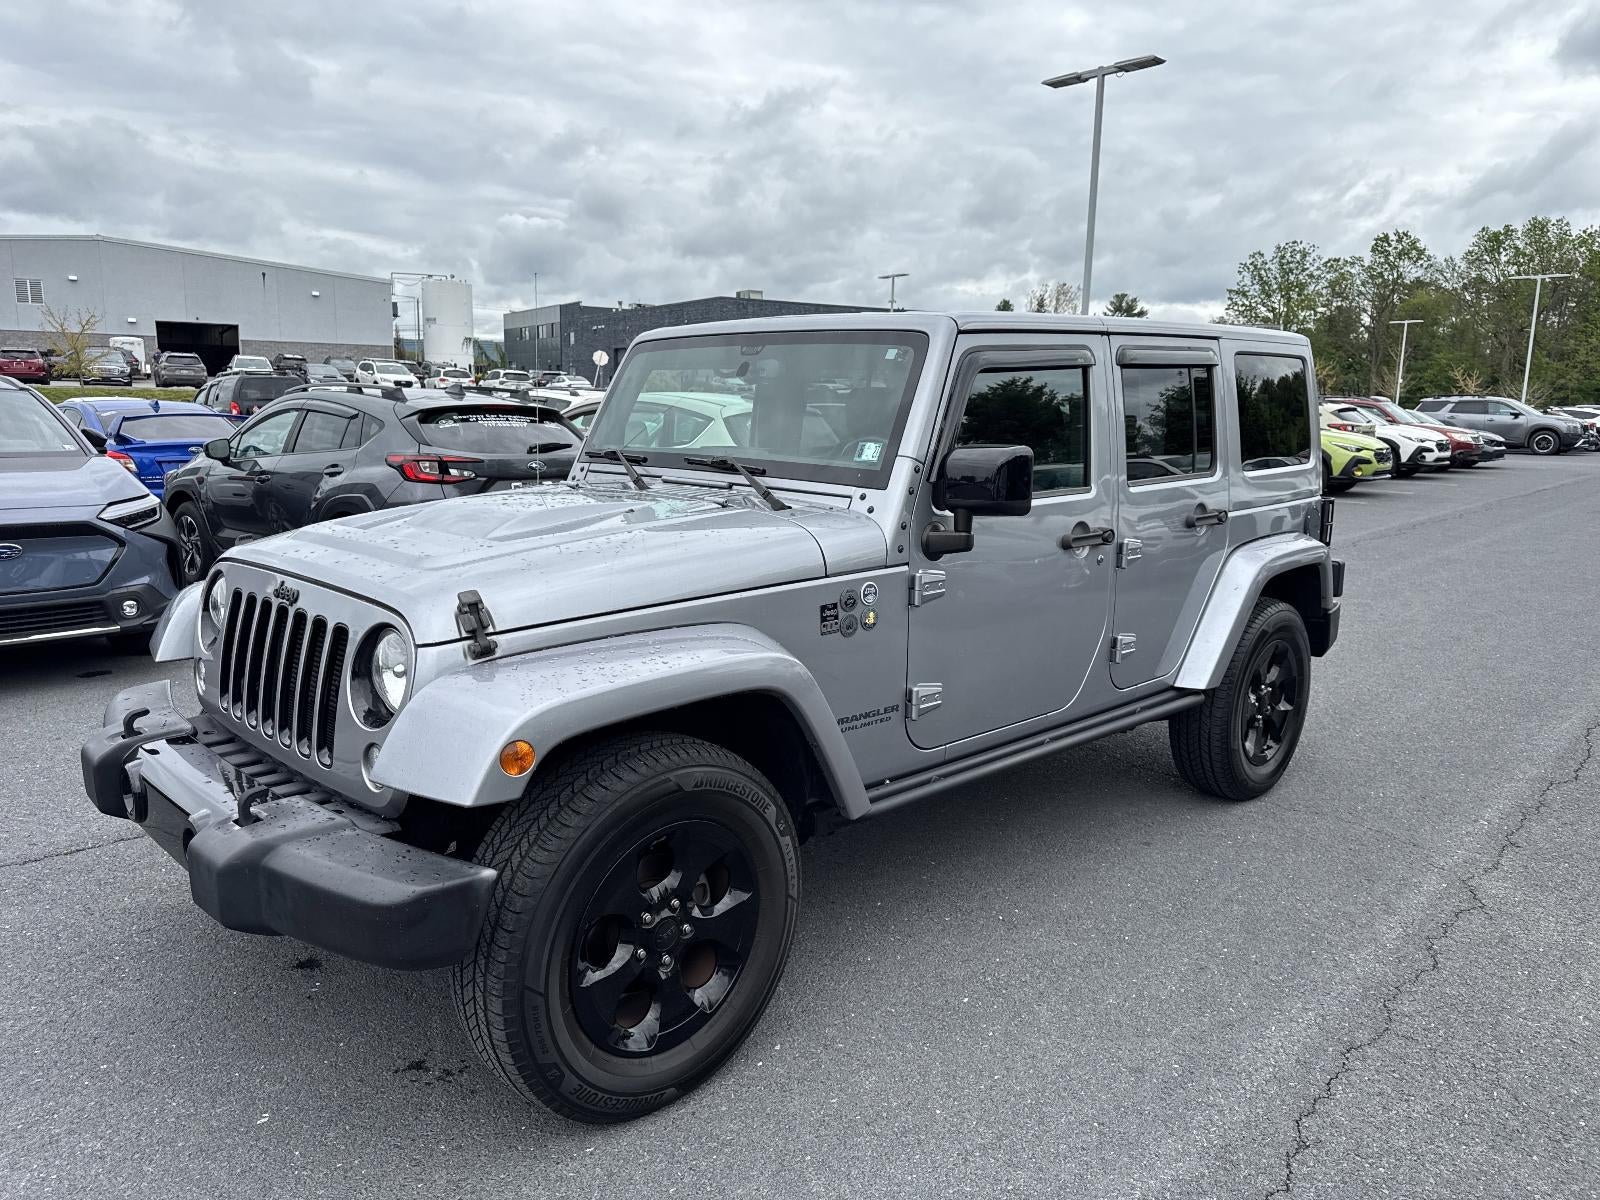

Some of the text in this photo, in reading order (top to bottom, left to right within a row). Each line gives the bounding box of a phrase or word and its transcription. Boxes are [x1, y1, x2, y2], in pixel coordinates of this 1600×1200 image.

[273, 580, 300, 607] Jeep
[841, 716, 892, 733] UNLIMITED
[691, 774, 772, 816] BRIDGESTONE
